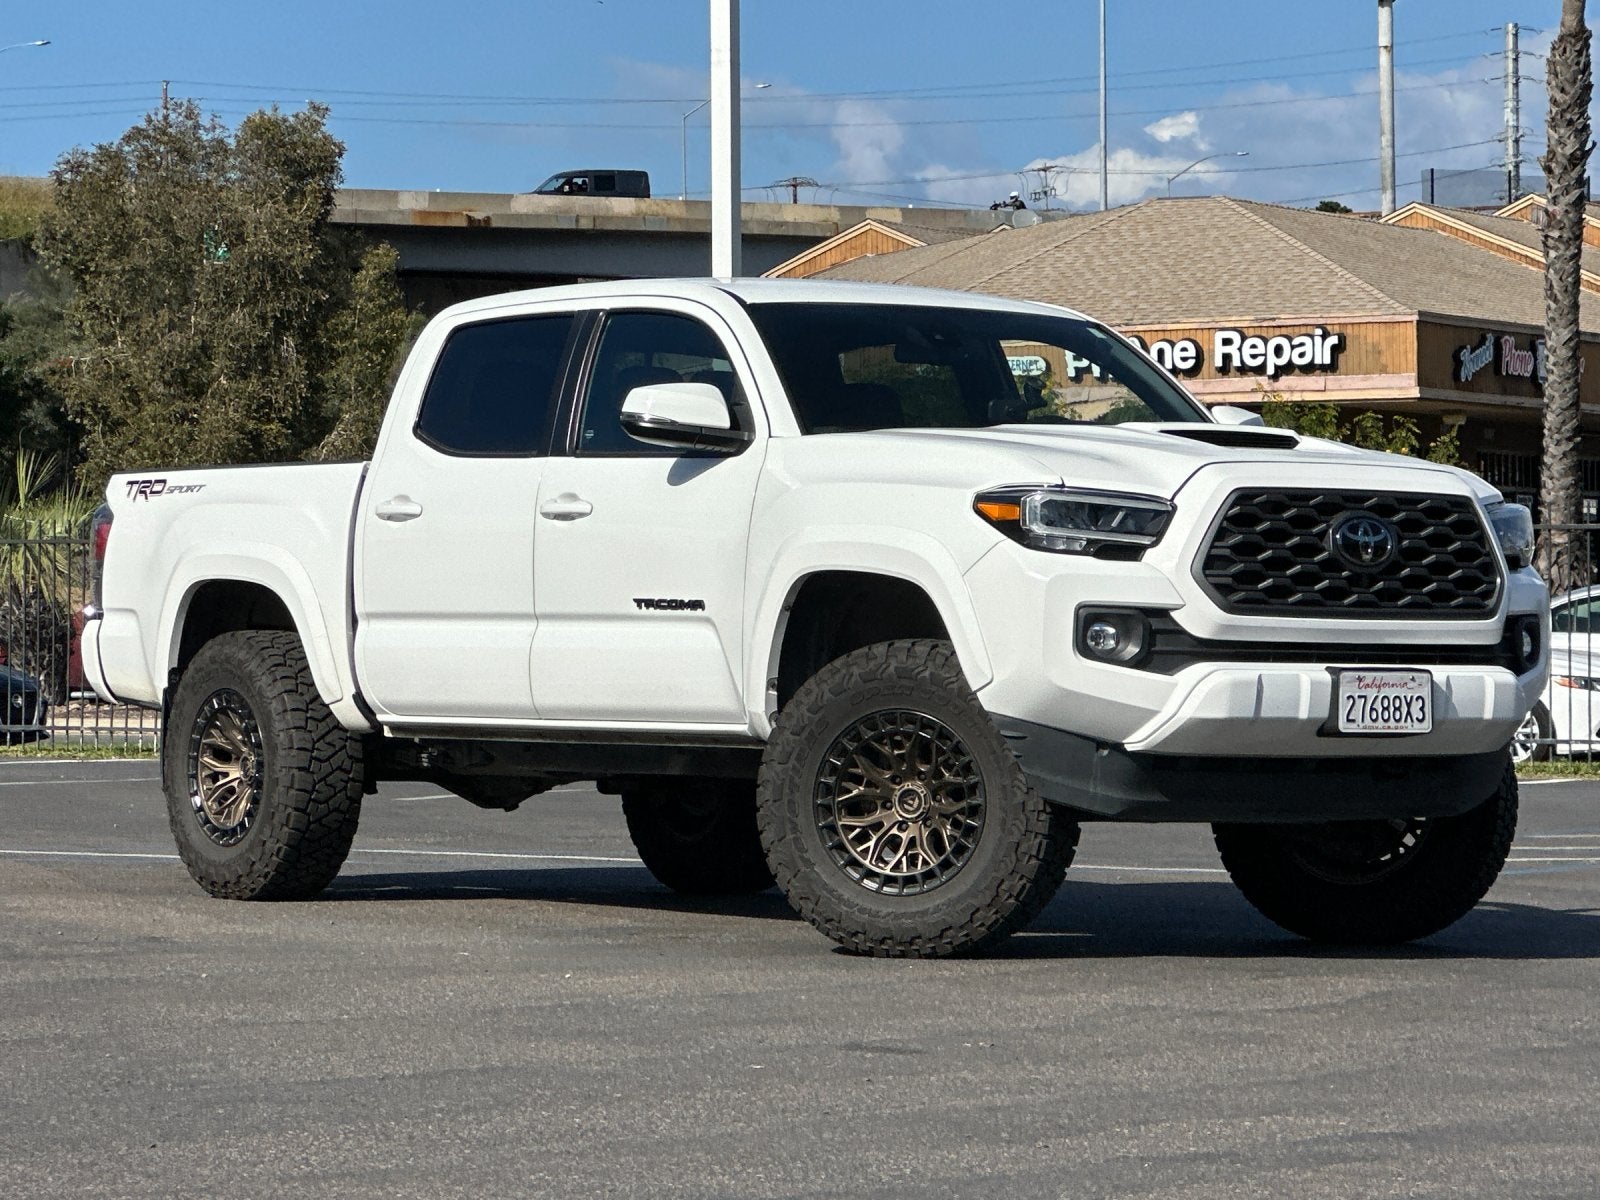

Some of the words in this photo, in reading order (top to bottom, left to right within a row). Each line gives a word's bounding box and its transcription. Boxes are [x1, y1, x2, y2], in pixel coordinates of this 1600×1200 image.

[1065, 336, 1196, 378] Pne
[1214, 327, 1339, 377] Repair
[1501, 335, 1534, 377] Phone
[126, 479, 167, 502] TRD
[165, 484, 207, 494] SPORT
[632, 598, 706, 611] TACOMA
[1357, 675, 1414, 693] California
[1346, 694, 1426, 723] 27688X3
